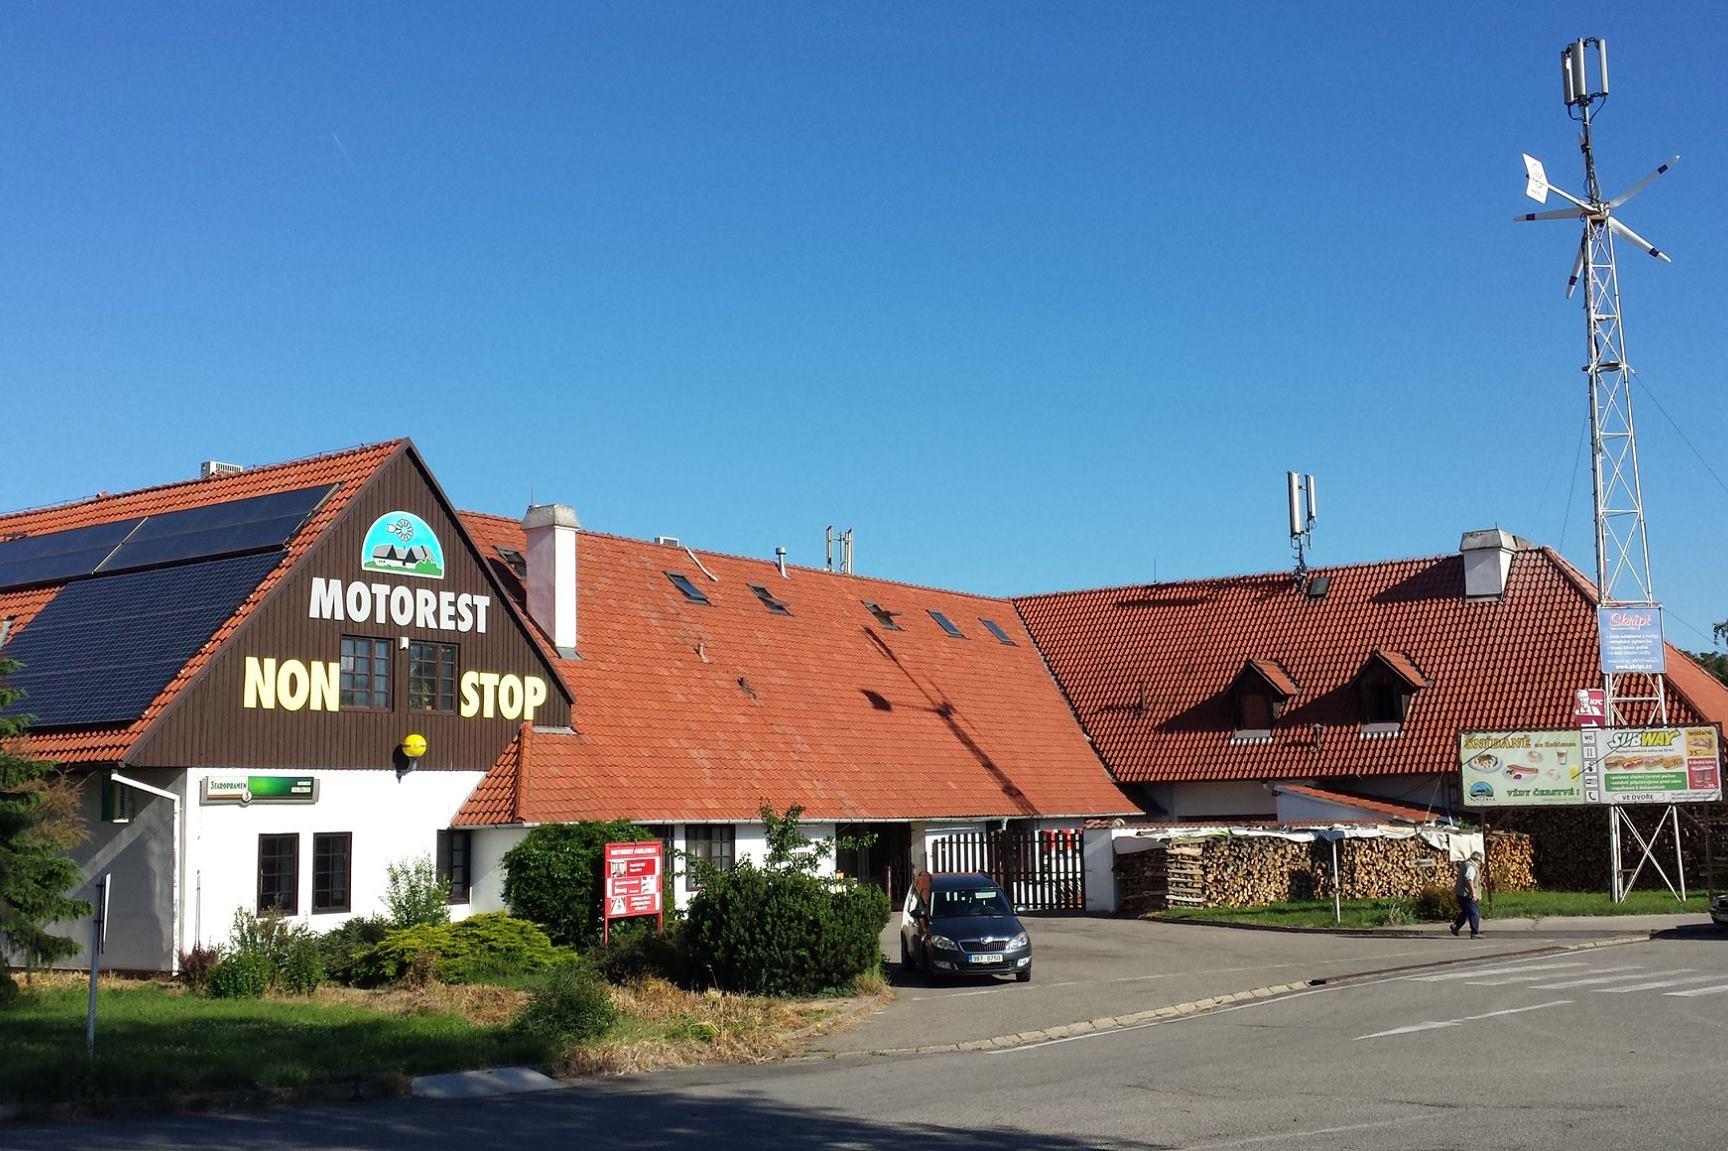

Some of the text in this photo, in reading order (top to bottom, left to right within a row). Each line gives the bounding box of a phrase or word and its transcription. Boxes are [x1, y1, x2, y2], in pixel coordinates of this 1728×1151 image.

[309, 577, 490, 634] MOTOREST
[1610, 612, 1652, 630] Skript
[243, 656, 547, 721] NON STOP
[1590, 698, 1604, 706] KFC
[1607, 729, 1681, 749] SUBWAY
